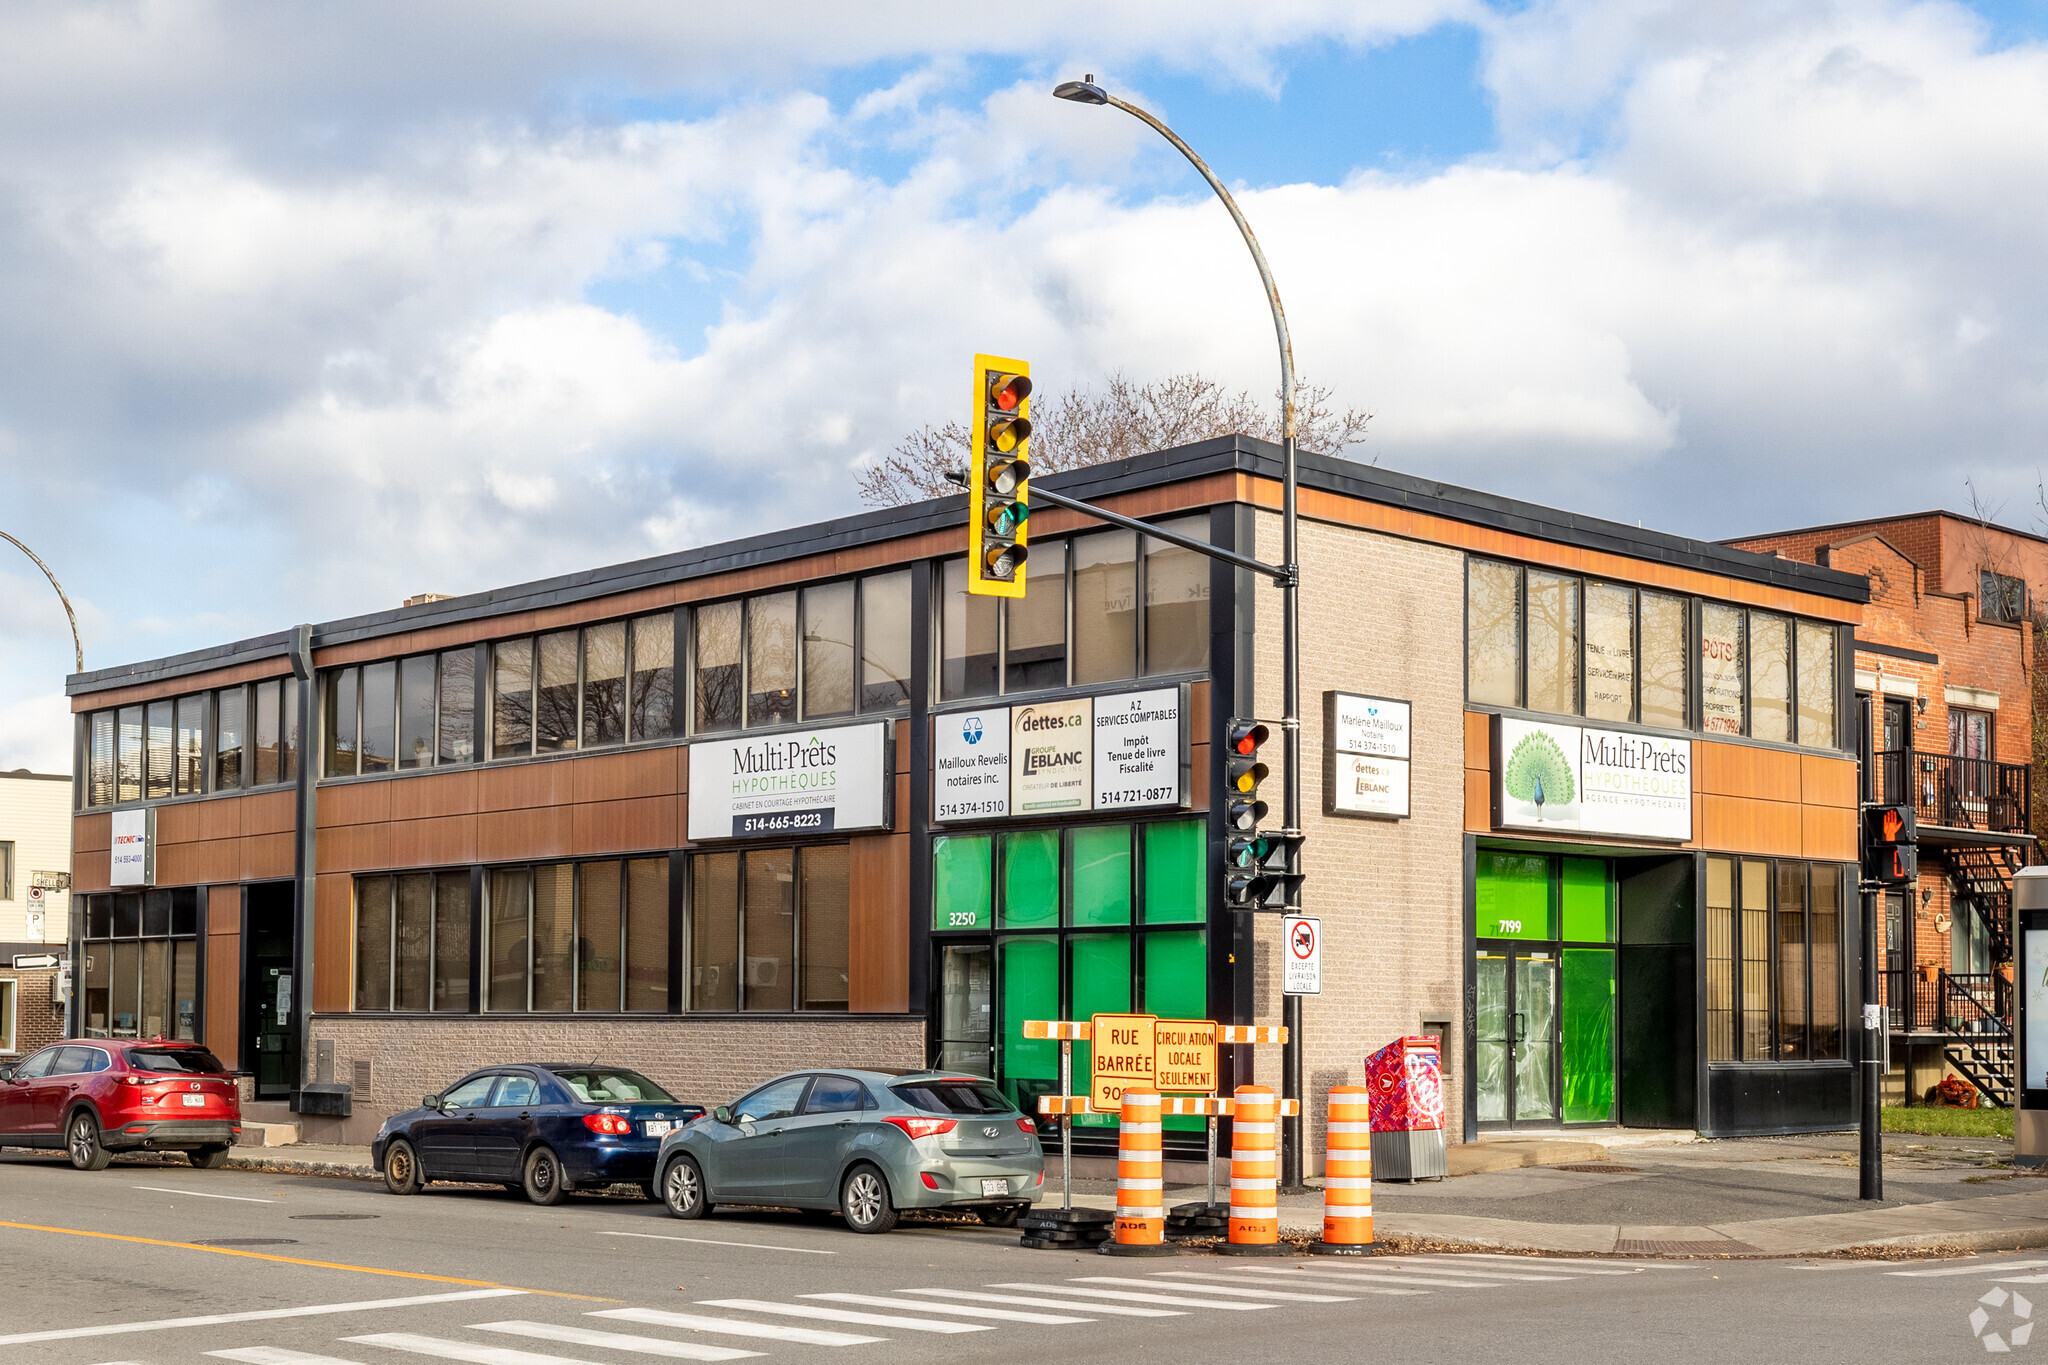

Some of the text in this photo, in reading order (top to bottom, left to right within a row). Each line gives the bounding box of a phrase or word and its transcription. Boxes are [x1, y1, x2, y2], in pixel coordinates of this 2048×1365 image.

[1594, 691, 1622, 703] RAPPORT
[1130, 700, 1142, 711] A Z
[1022, 714, 1082, 732] dettes.ca
[1096, 709, 1177, 727] SERVICES COMPTABLES
[1372, 719, 1403, 731] Mailloux
[1123, 735, 1149, 748] Impôt
[1361, 729, 1384, 740] Notaire
[1031, 746, 1056, 755] GROUPE
[1349, 739, 1396, 754] 514 374-1510
[733, 737, 837, 775] Multi-Prêts
[1107, 748, 1166, 761] Tenue de livre
[1585, 734, 1686, 774] Multi-Prêts
[938, 753, 1008, 770] Mailloux Revelis
[1022, 748, 1082, 776] LEBLANC
[1119, 761, 1154, 774] Fiscalité
[1037, 765, 1082, 776] SYNDIC INC
[732, 770, 837, 794] HYPOTHÈQUES
[947, 773, 999, 787] notaires inc.
[1059, 779, 1082, 788] LIBERTÉ
[1355, 777, 1390, 795] LEBLANC
[1101, 787, 1173, 804] 514 721-0877
[1585, 793, 1619, 805] AGENCE
[732, 800, 755, 811] CABINET
[755, 799, 763, 808] EN
[764, 798, 793, 808] COURTAGE
[939, 800, 1004, 816] 514 374-1510
[744, 813, 822, 831] 514-665-8223
[114, 856, 123, 864] 514
[36, 878, 64, 887] SHELLEY
[949, 911, 976, 926] 3250
[1498, 919, 1522, 934] 7199
[1293, 982, 1312, 991] LOCALE
[1111, 1029, 1139, 1045] RUE
[1156, 1031, 1214, 1046] CIRCULATION
[1097, 1053, 1152, 1072] BARRÉE
[1168, 1052, 1201, 1065] LOCALE
[1160, 1071, 1211, 1086] SEULEMENT
[1102, 1086, 1127, 1100] 90
[1120, 1222, 1147, 1230] ADS
